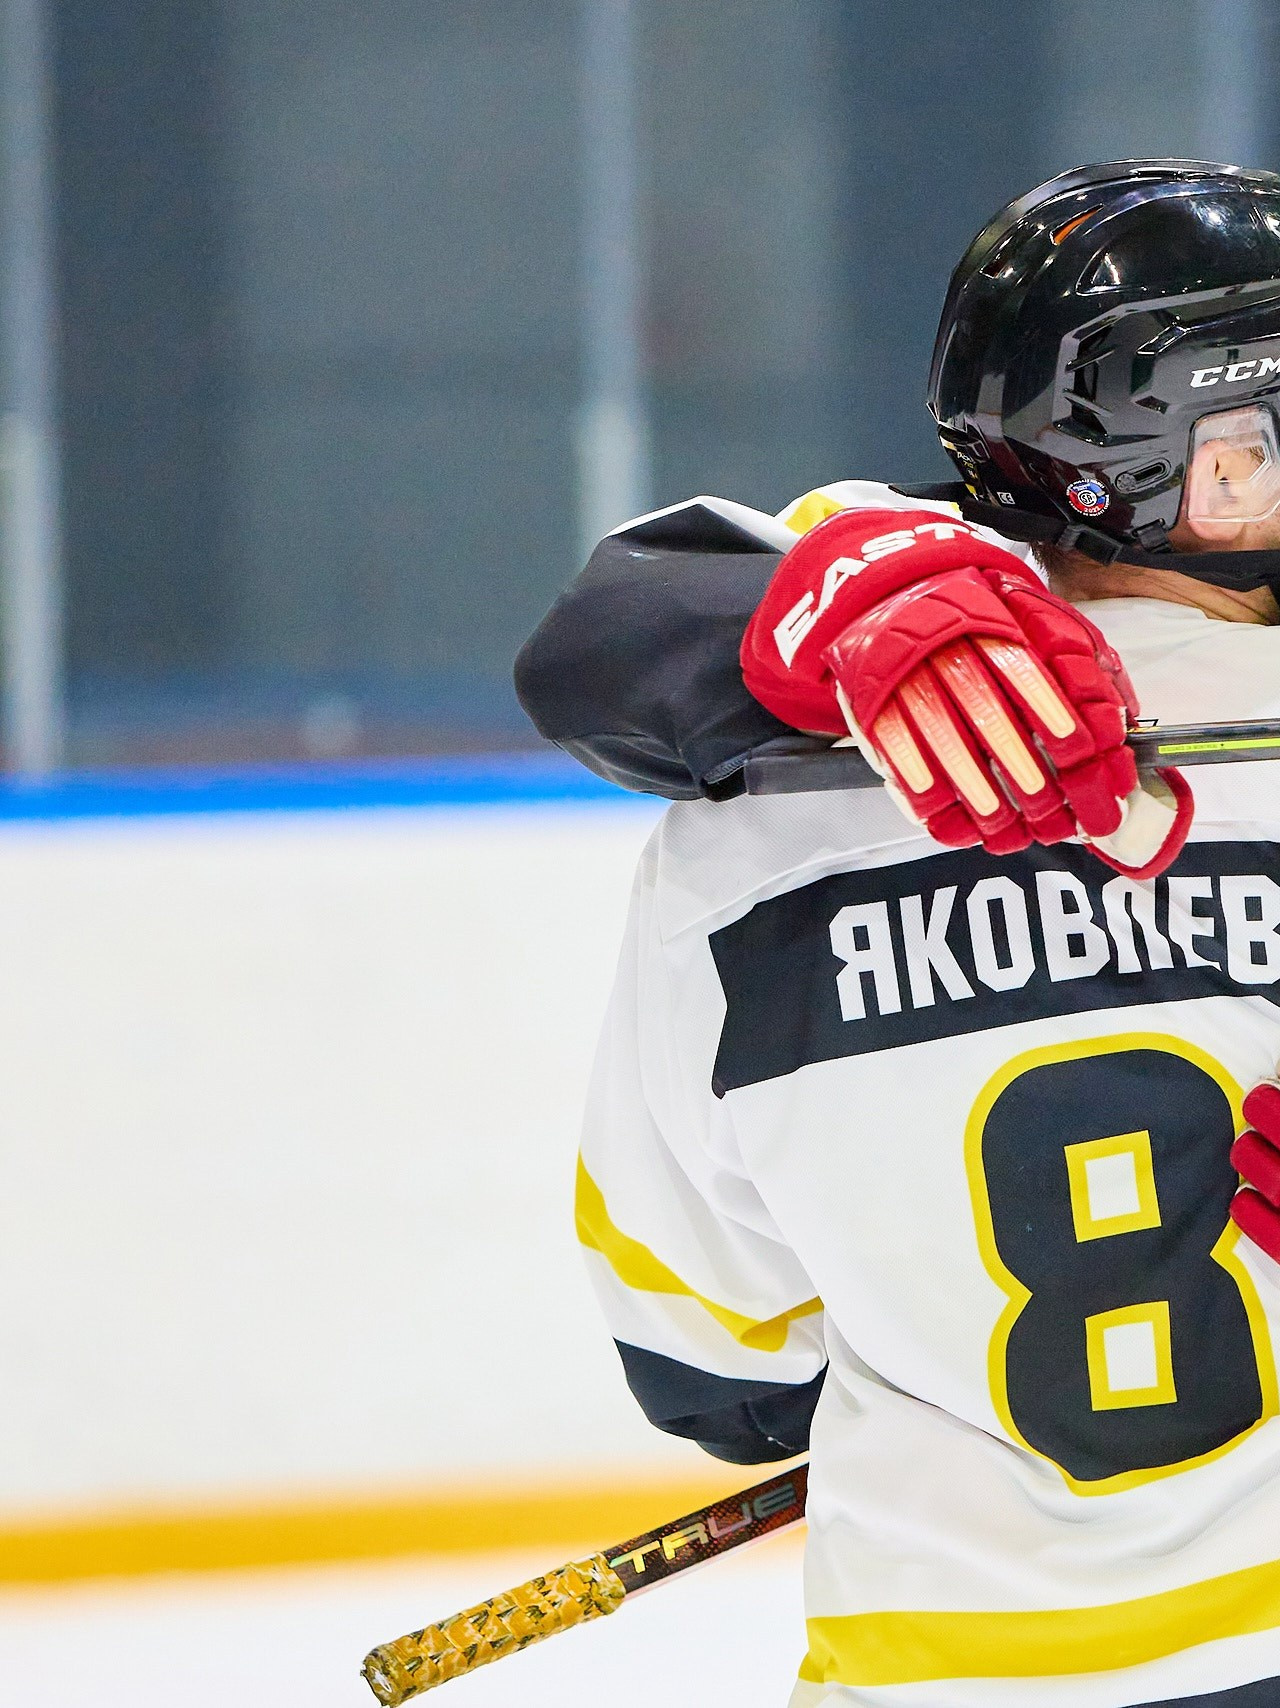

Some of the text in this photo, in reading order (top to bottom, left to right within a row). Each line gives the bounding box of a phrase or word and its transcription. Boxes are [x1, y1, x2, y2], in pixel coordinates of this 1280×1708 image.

[773, 522, 986, 671] EAST
[963, 1032, 1280, 1498] 8
[609, 1482, 797, 1574] TRUE
